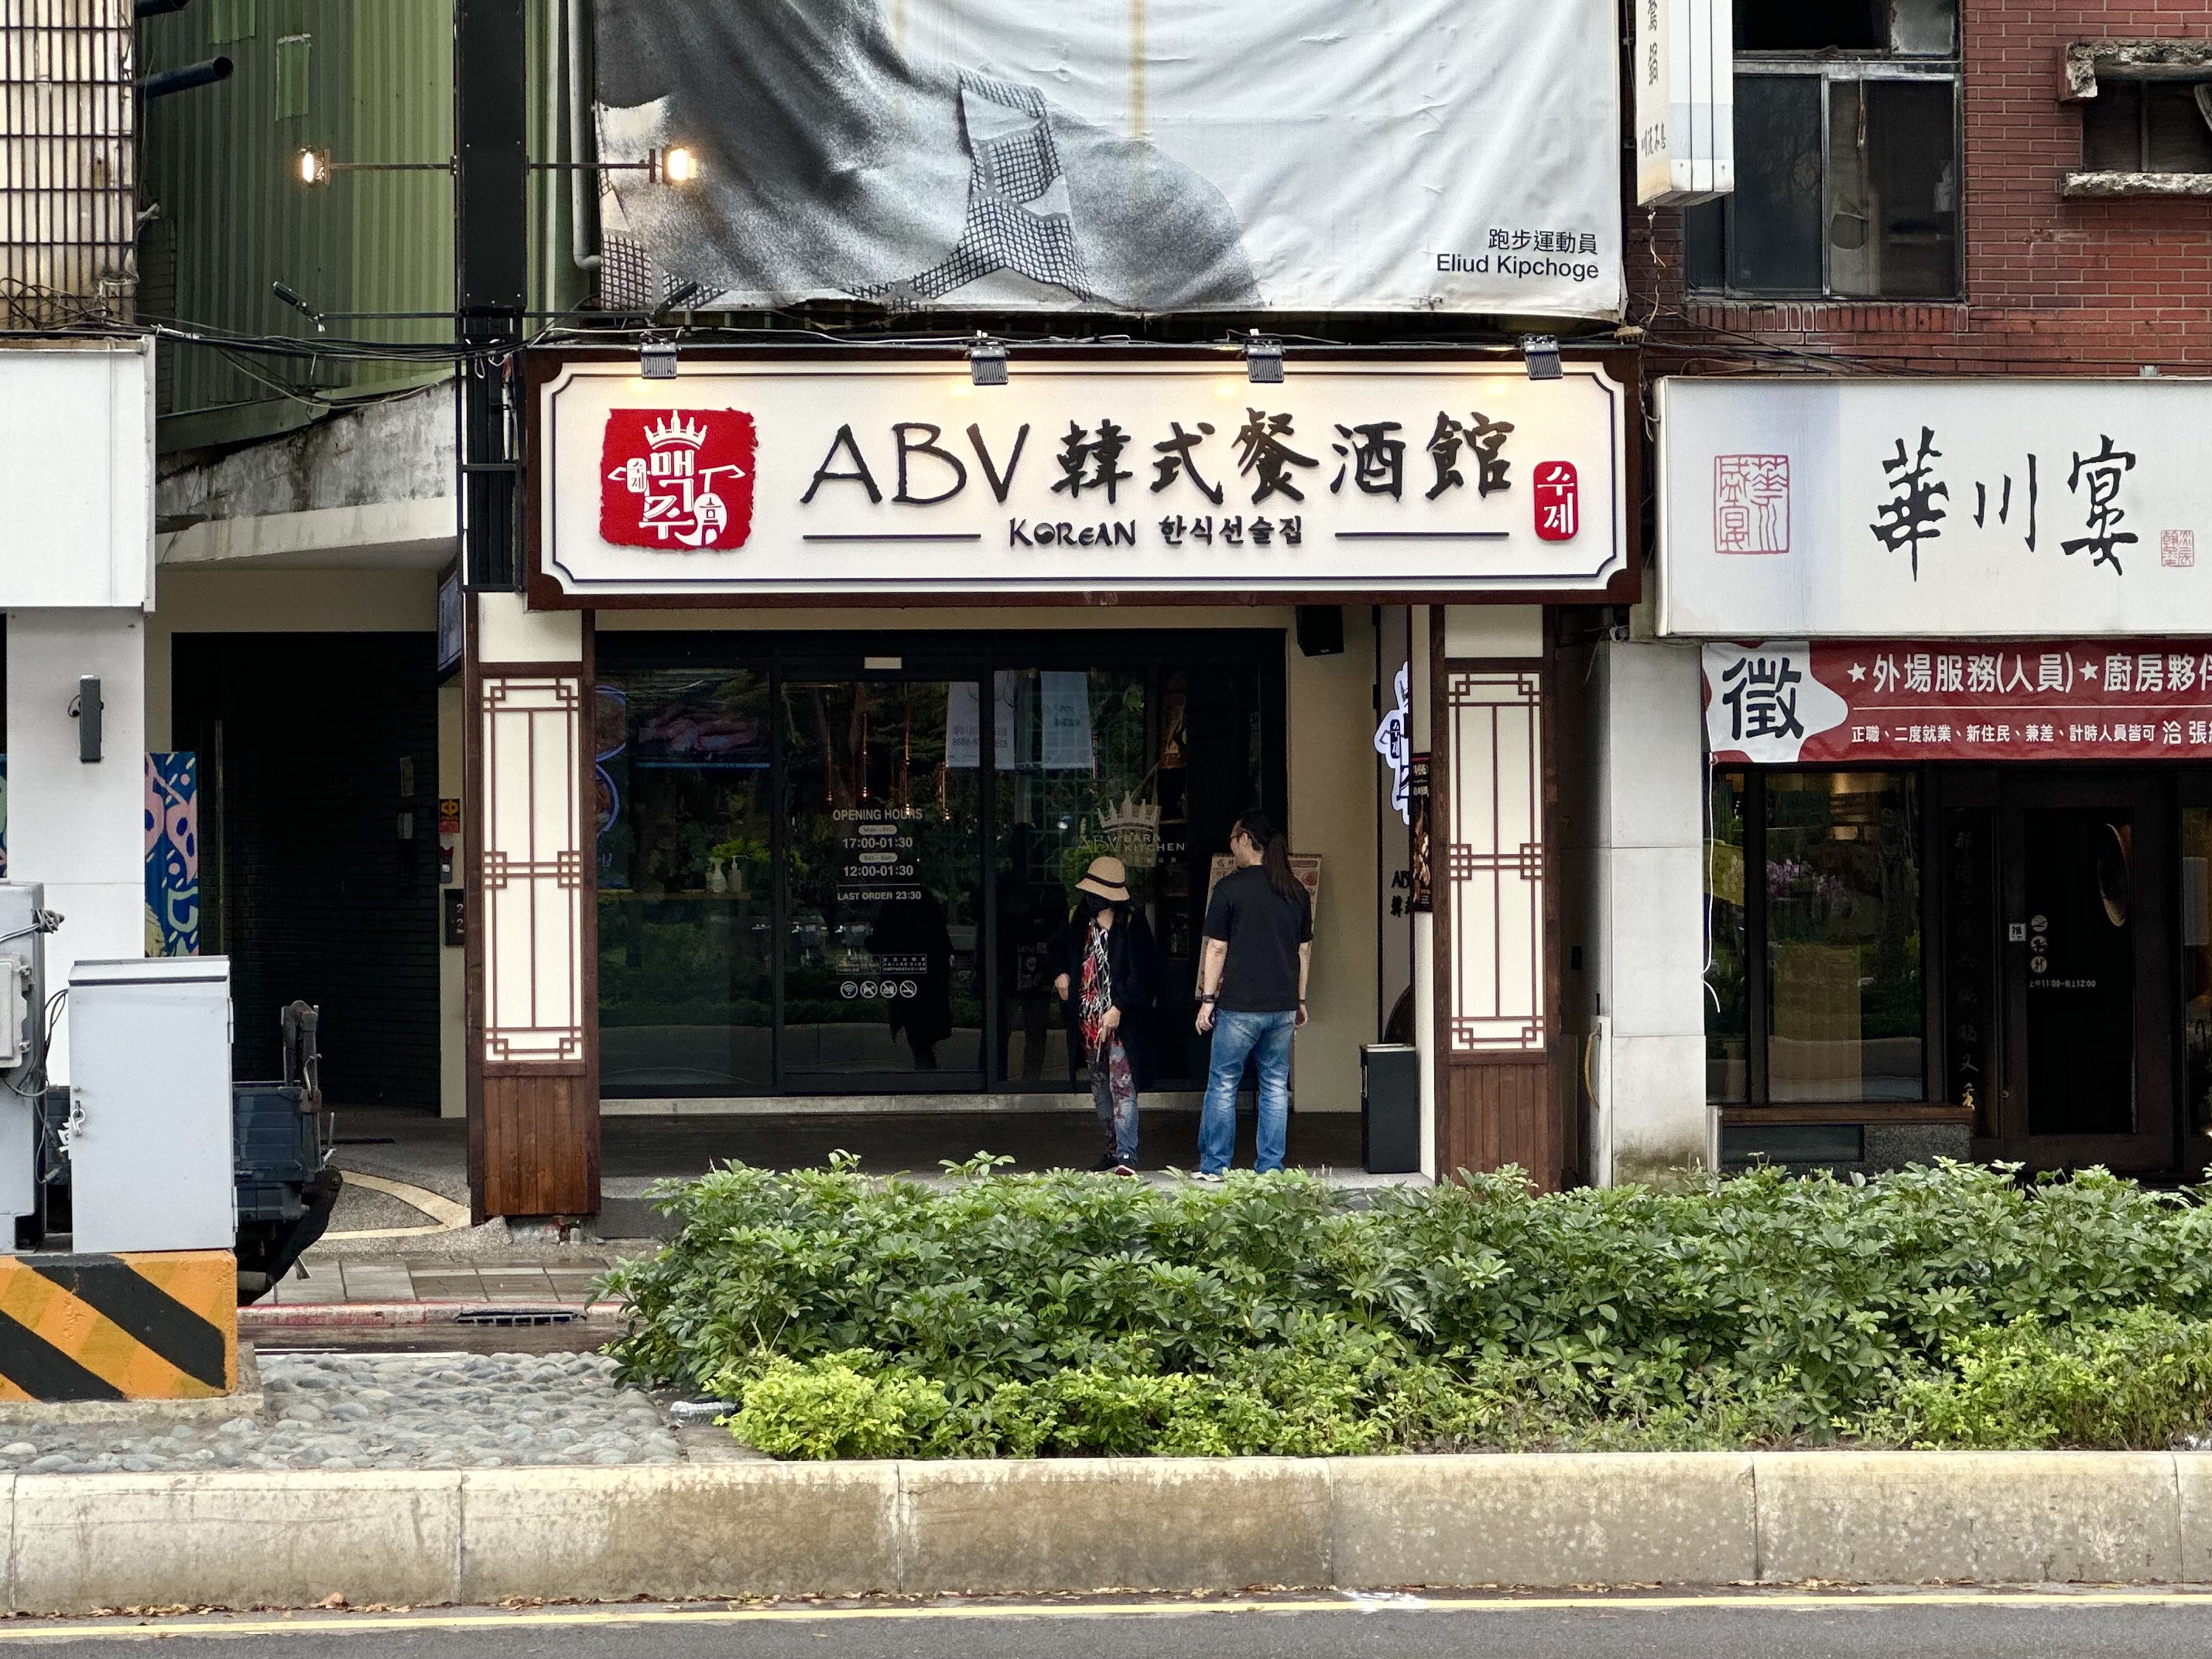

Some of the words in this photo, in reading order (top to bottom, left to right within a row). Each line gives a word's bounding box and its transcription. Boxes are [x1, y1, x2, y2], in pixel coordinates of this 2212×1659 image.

[1488, 227, 1598, 255] 跑步運動員
[1436, 253, 1488, 273] Eliud
[1497, 255, 1599, 282] Kipchoge
[800, 422, 1030, 505] ABV
[1050, 408, 1515, 505] 韓式餐酒館
[1537, 466, 1575, 534] 수제
[1869, 426, 2138, 583] 華川宴
[1159, 515, 1302, 545] 한식선술집
[1722, 657, 1804, 741] 徵
[2162, 720, 2183, 745] 洽
[2188, 720, 2212, 745] 張
[832, 809, 882, 821] OPENING
[884, 809, 923, 820] HOURS
[842, 836, 913, 849] 17:00-01:30
[843, 864, 914, 877] 12:00-01:30
[837, 892, 860, 901] LAST
[861, 891, 893, 900] ORDER
[895, 891, 922, 900] 23:30
